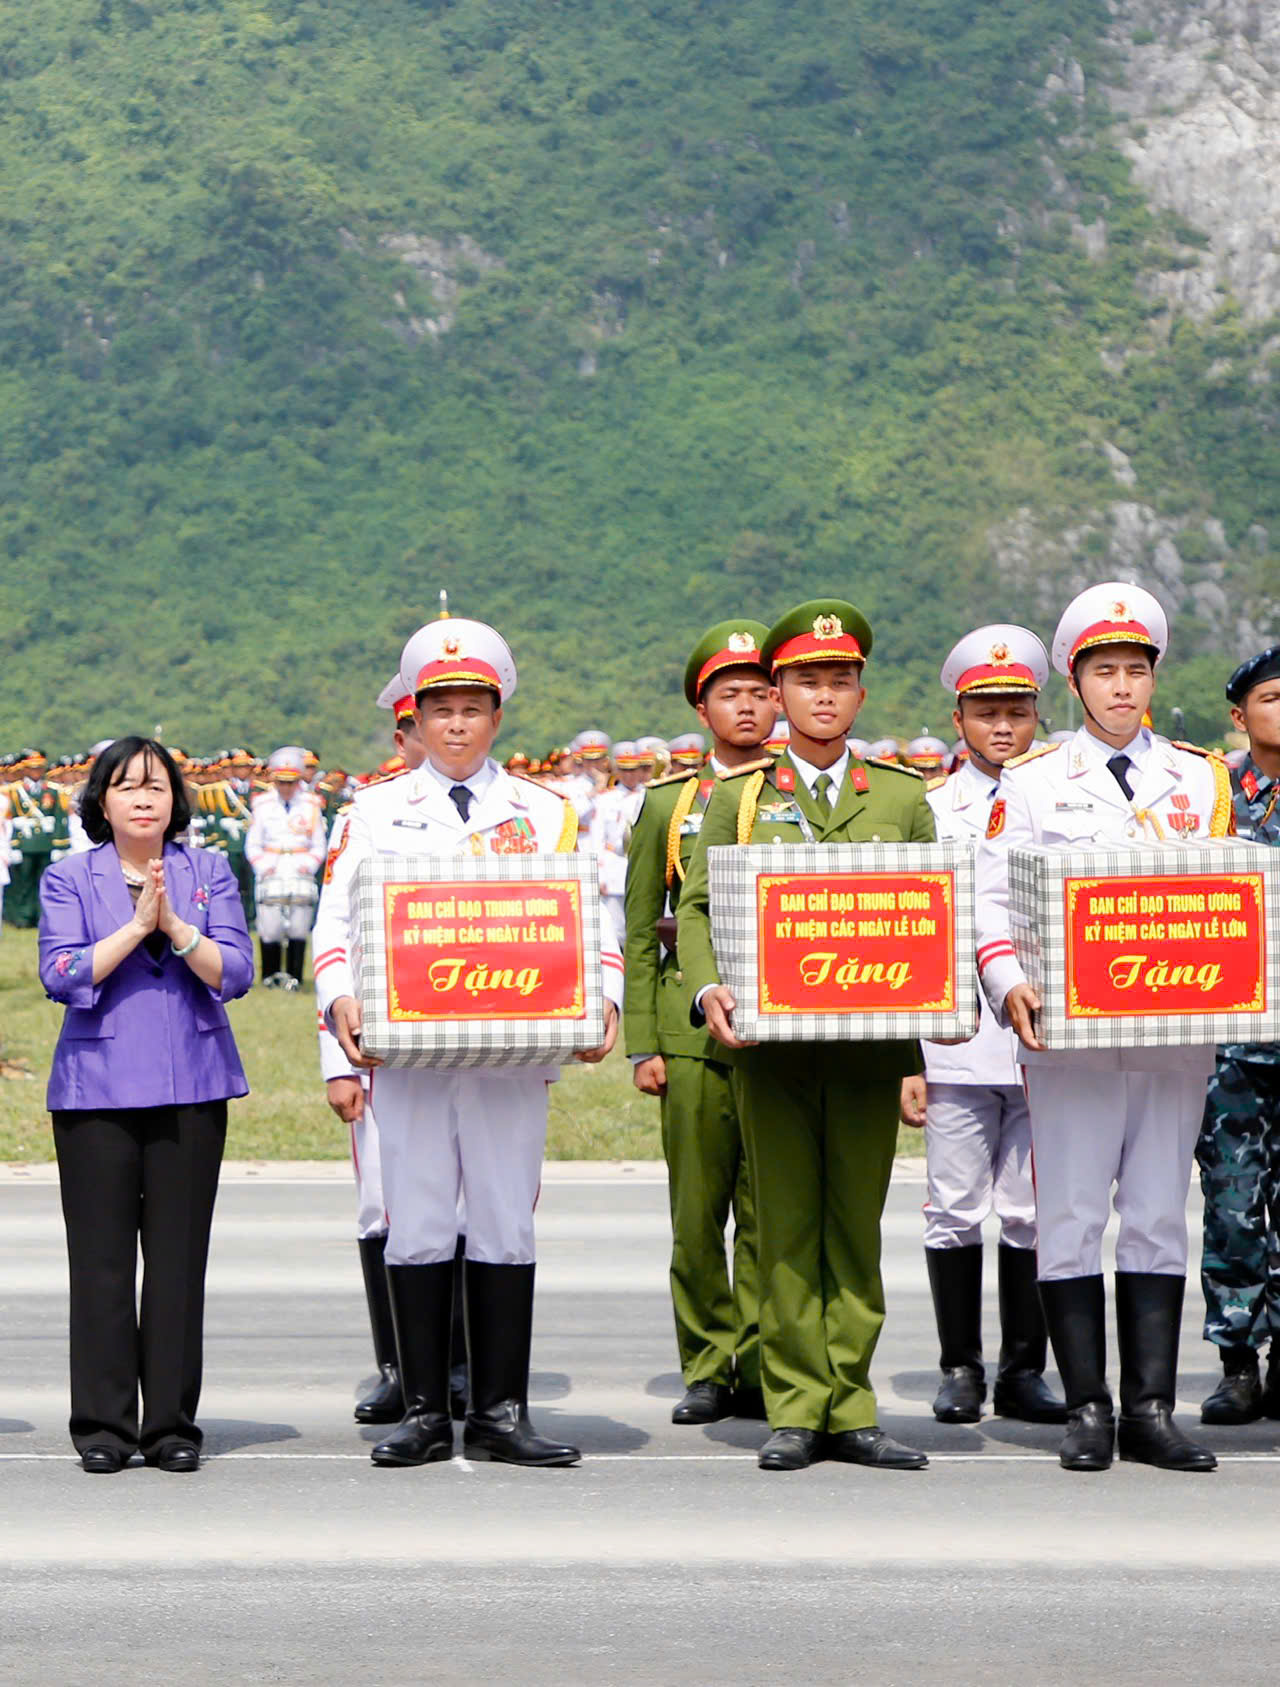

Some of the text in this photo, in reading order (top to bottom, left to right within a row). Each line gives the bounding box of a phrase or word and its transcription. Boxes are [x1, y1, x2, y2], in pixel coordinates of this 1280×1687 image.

[408, 902, 432, 919] BAN
[484, 900, 522, 917] TRUNG
[780, 888, 930, 914] BAN CHỈ ĐẠO TRUNG ƯƠNG
[1090, 891, 1241, 916] BAN CHỈ ĐẠO TRUNG ƯƠNG
[459, 926, 483, 943] CÁC
[486, 924, 520, 942] NGÀY
[795, 919, 827, 941] NIỆM
[830, 918, 856, 937] CÁC
[858, 917, 891, 936] NGÀY
[912, 917, 936, 936] LỚN
[1104, 922, 1137, 944] NIỆM
[1140, 921, 1165, 940] CÁC
[1168, 920, 1201, 939] NGÀY
[1222, 919, 1247, 937] LỚN
[428, 958, 543, 996] Tặng
[800, 952, 912, 990] Tặng
[1109, 955, 1223, 992] Tặng
